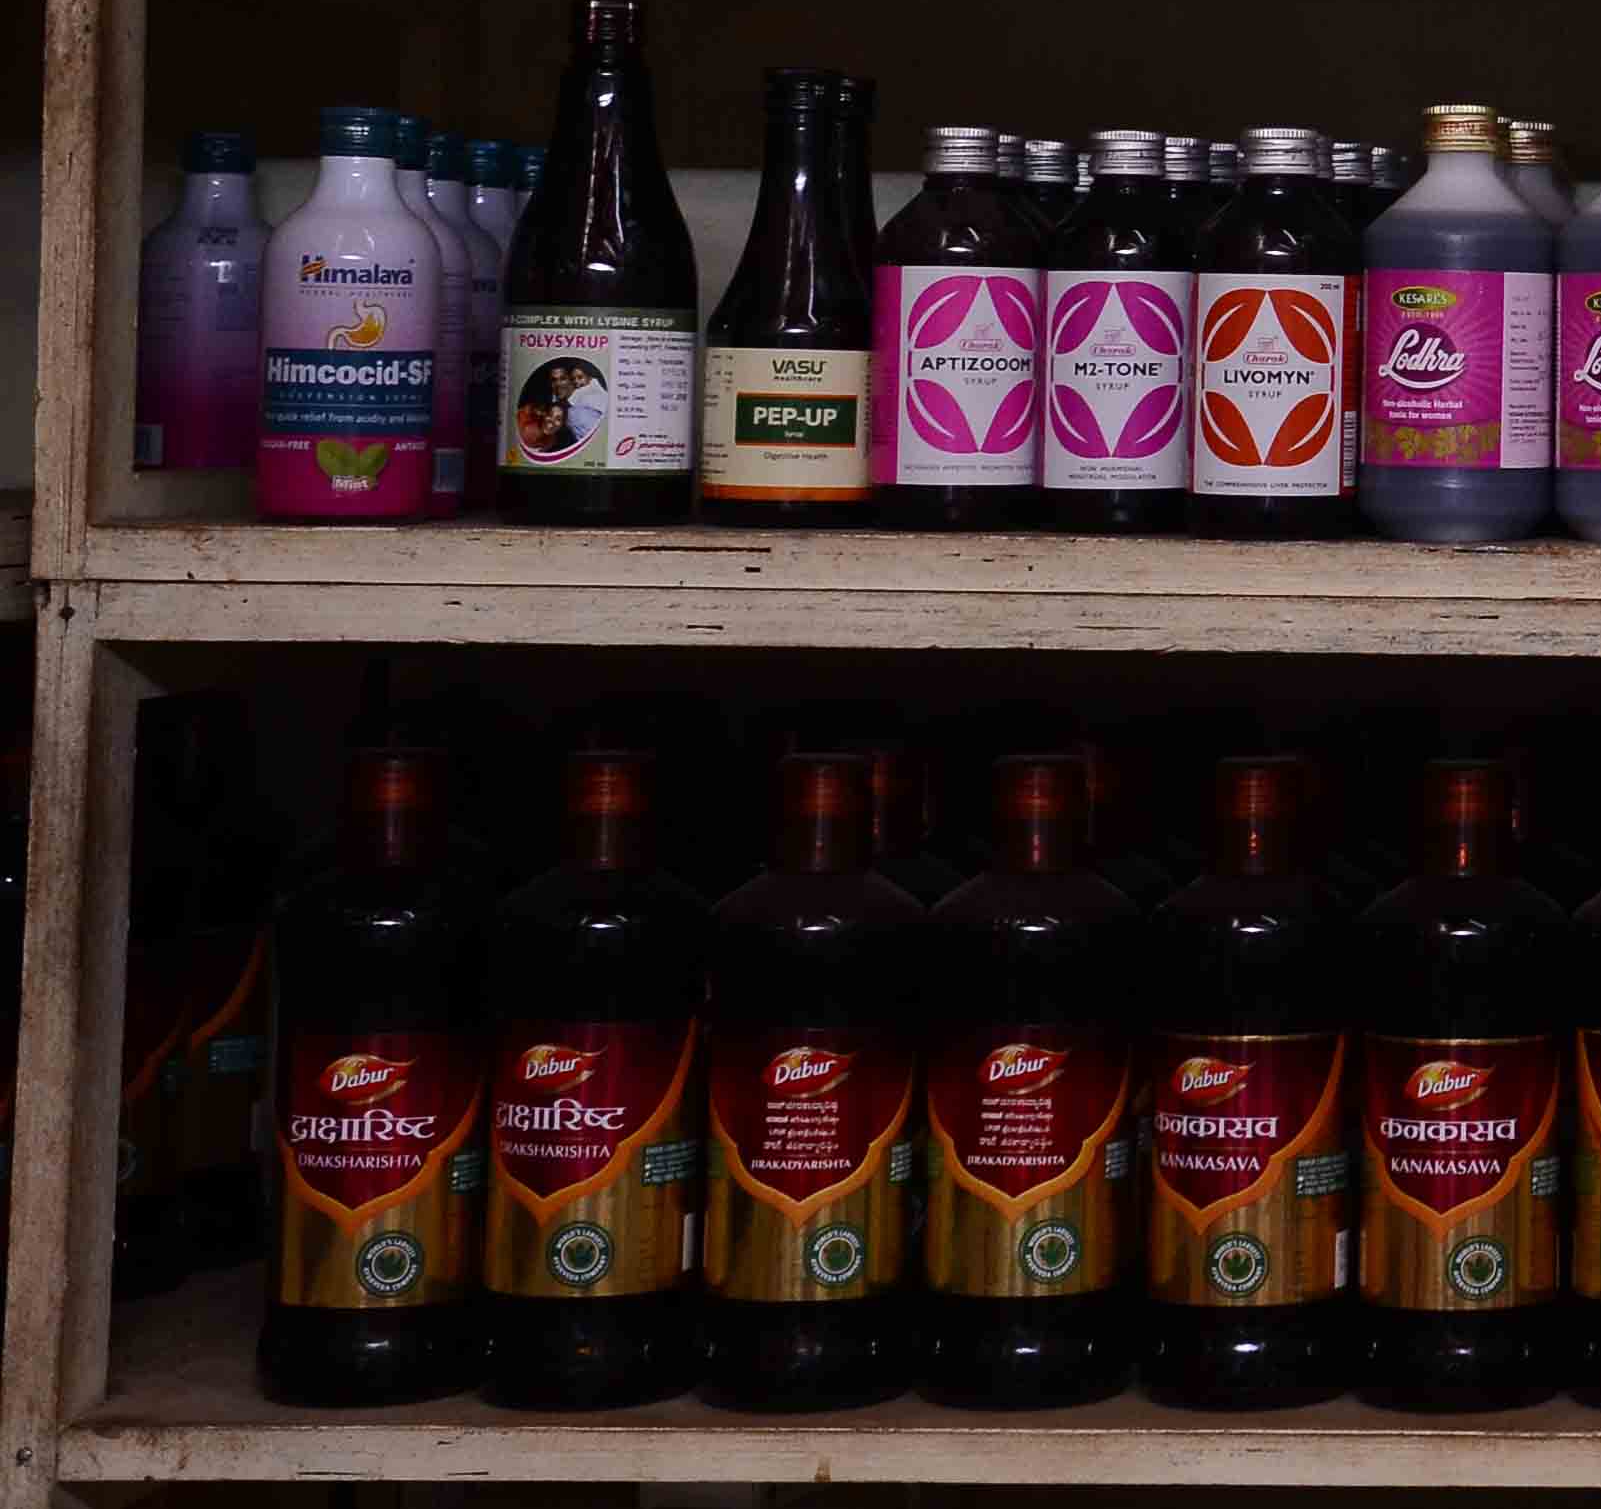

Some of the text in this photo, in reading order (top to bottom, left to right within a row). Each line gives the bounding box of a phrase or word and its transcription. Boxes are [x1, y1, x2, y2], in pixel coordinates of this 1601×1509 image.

[300, 254, 413, 285] Himalaya
[519, 334, 609, 349] POLYSYRUP
[772, 359, 824, 375] VASU
[920, 355, 1030, 373] APTIZOOOM
[1378, 328, 1465, 389] Lodhra
[1074, 362, 1160, 378] M2-TONE
[1223, 368, 1311, 386] LIVOMYN
[753, 406, 838, 427] PEP-UP
[1408, 411, 1420, 420] for
[1421, 412, 1452, 420] women
[525, 1056, 582, 1081] Dabur
[774, 1059, 837, 1086] Dabur
[989, 1057, 1049, 1082] Dabur
[331, 1066, 394, 1092] Dabur
[1181, 1069, 1235, 1092] Dabur
[1417, 1073, 1476, 1098] Dabur
[1154, 1112, 1279, 1140] कनकासव
[1380, 1116, 1518, 1141] कनकासव
[298, 1153, 422, 1169] DRAKSHARISHTA
[751, 1158, 852, 1171] JIRAKADYARISHTA
[967, 1154, 1065, 1167] JIRAKADYARISHTA
[1160, 1155, 1260, 1172] KANAKASAVA
[1390, 1157, 1501, 1175] KANAKASAVA
